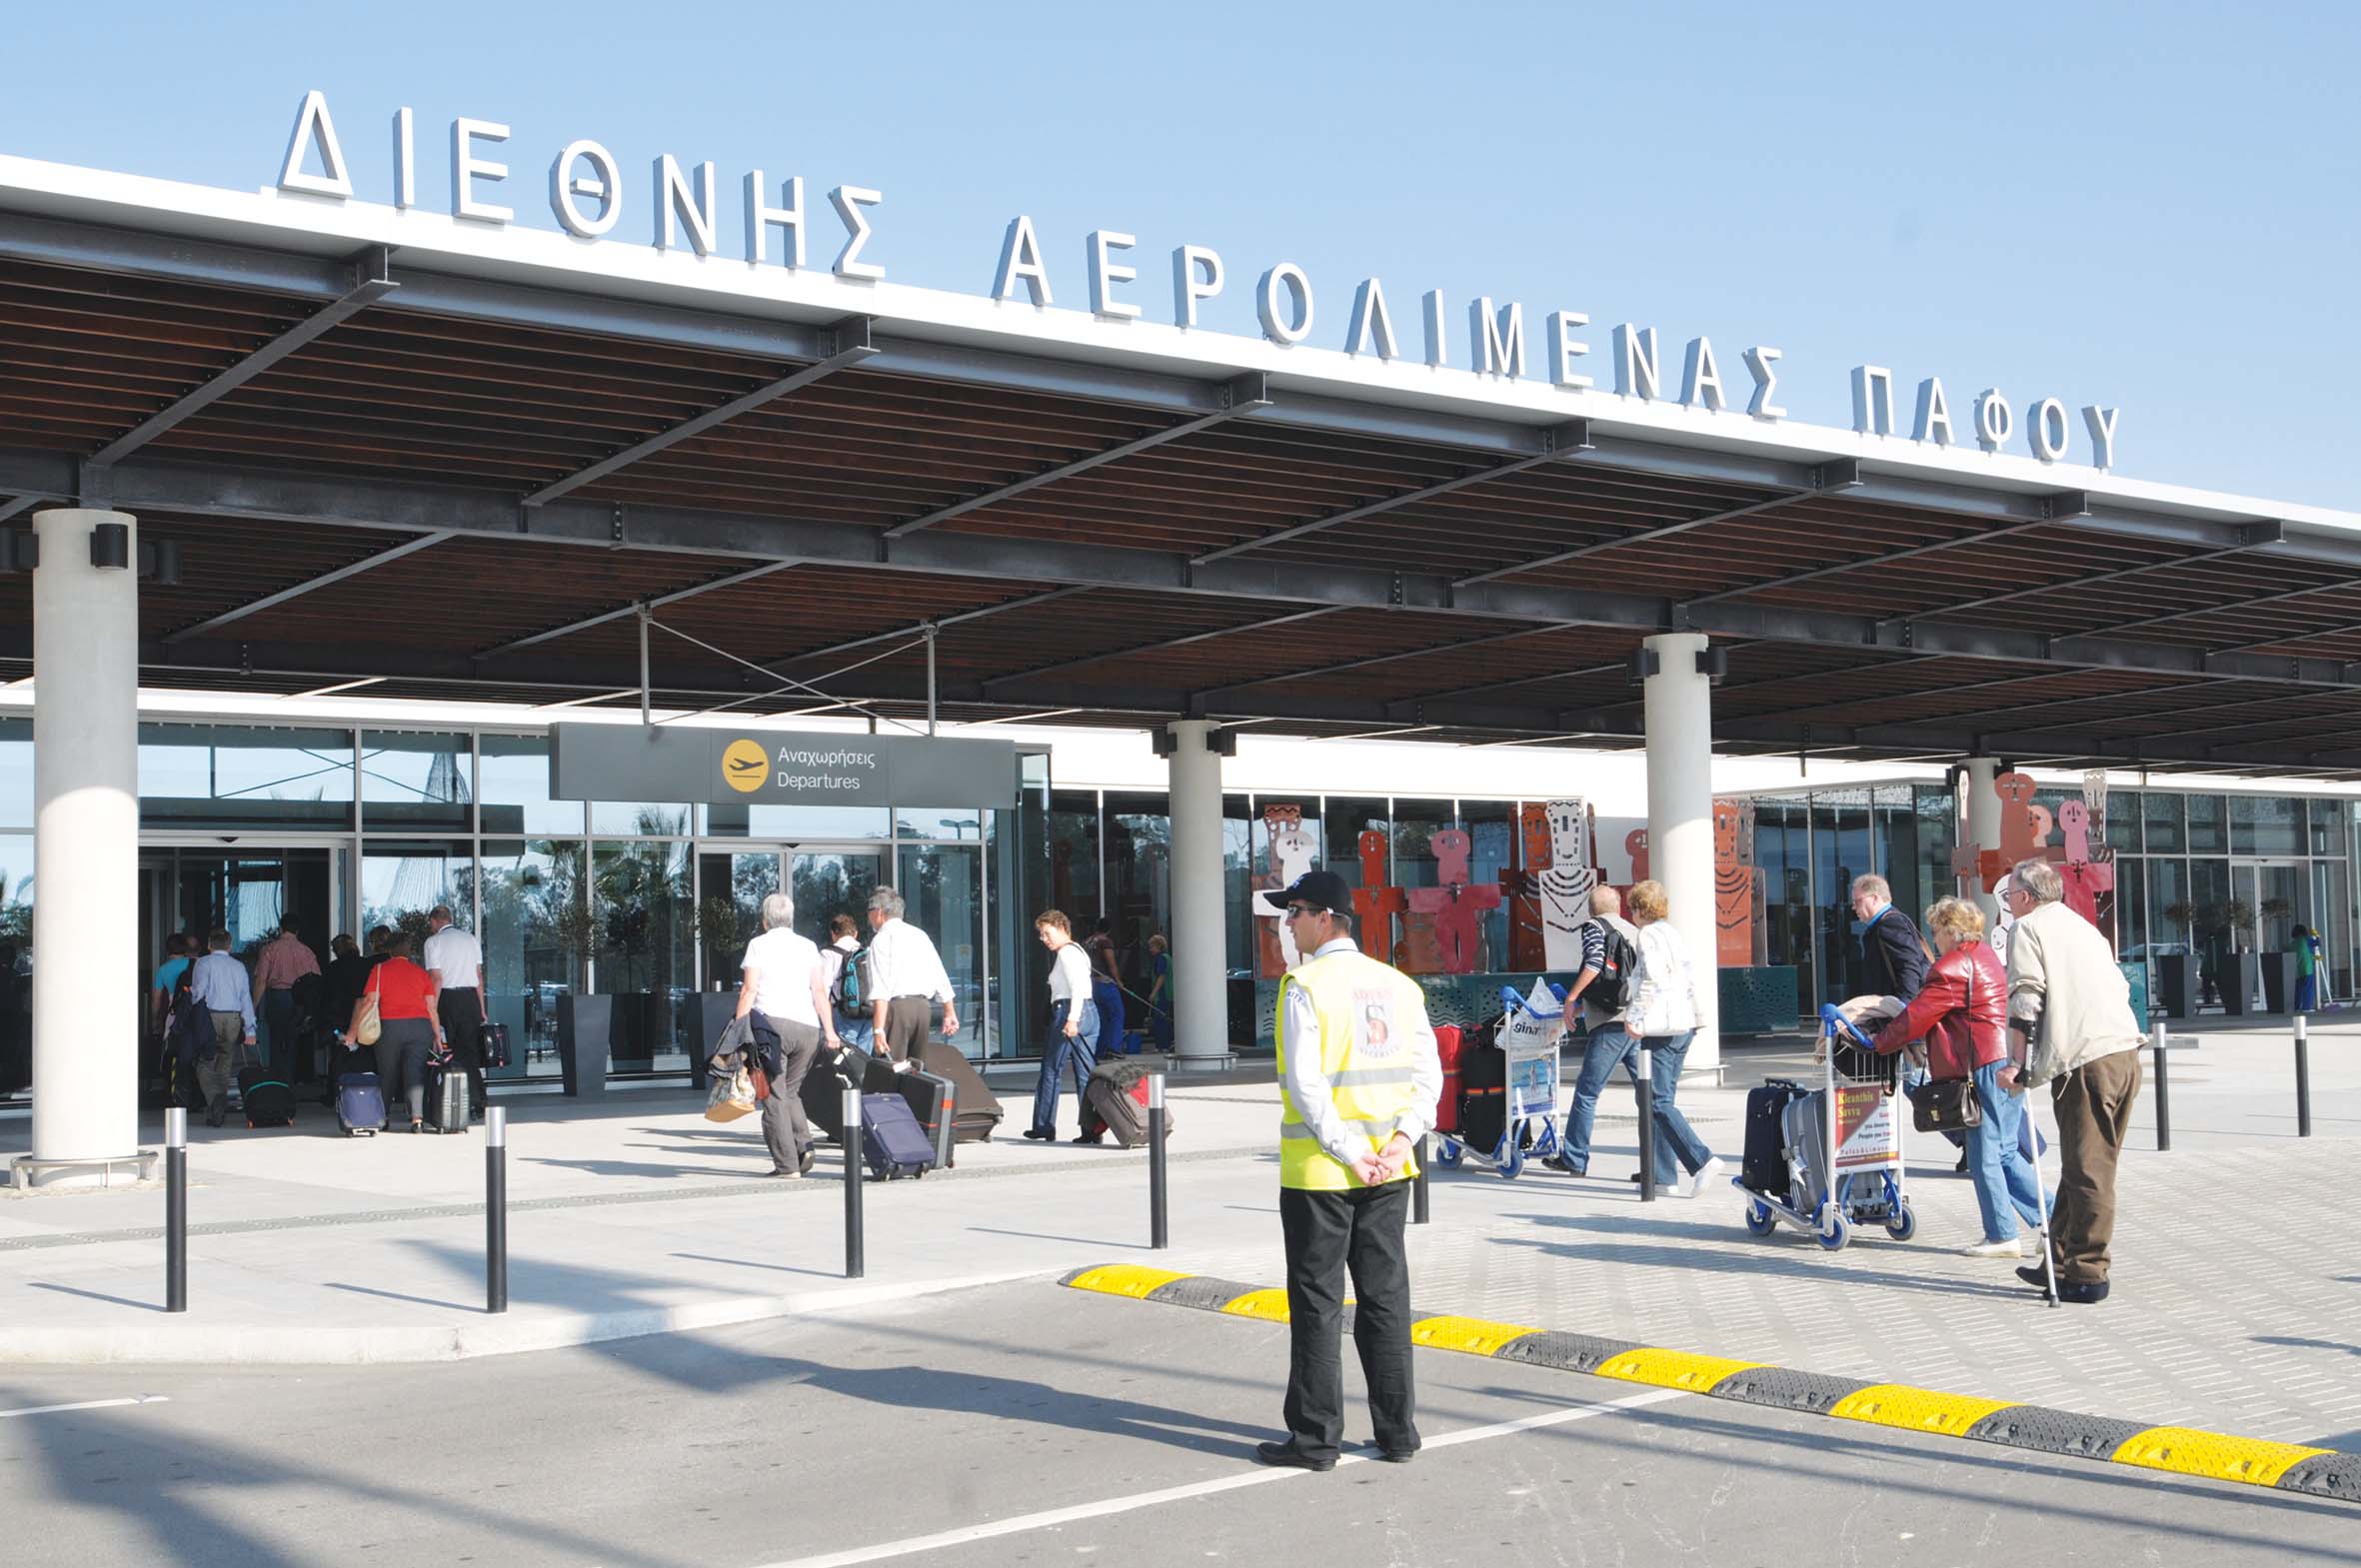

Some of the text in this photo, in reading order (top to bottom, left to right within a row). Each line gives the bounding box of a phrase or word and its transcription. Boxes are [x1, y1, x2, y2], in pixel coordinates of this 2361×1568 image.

[278, 90, 2119, 470] ΔΙΕΘΝΗΣ ΑΕΡΟΛΙΜΕΝΑΣ ΠΑΦΟΥ
[778, 747, 877, 768] Αναχωρήσεις
[778, 772, 861, 790] Departures
